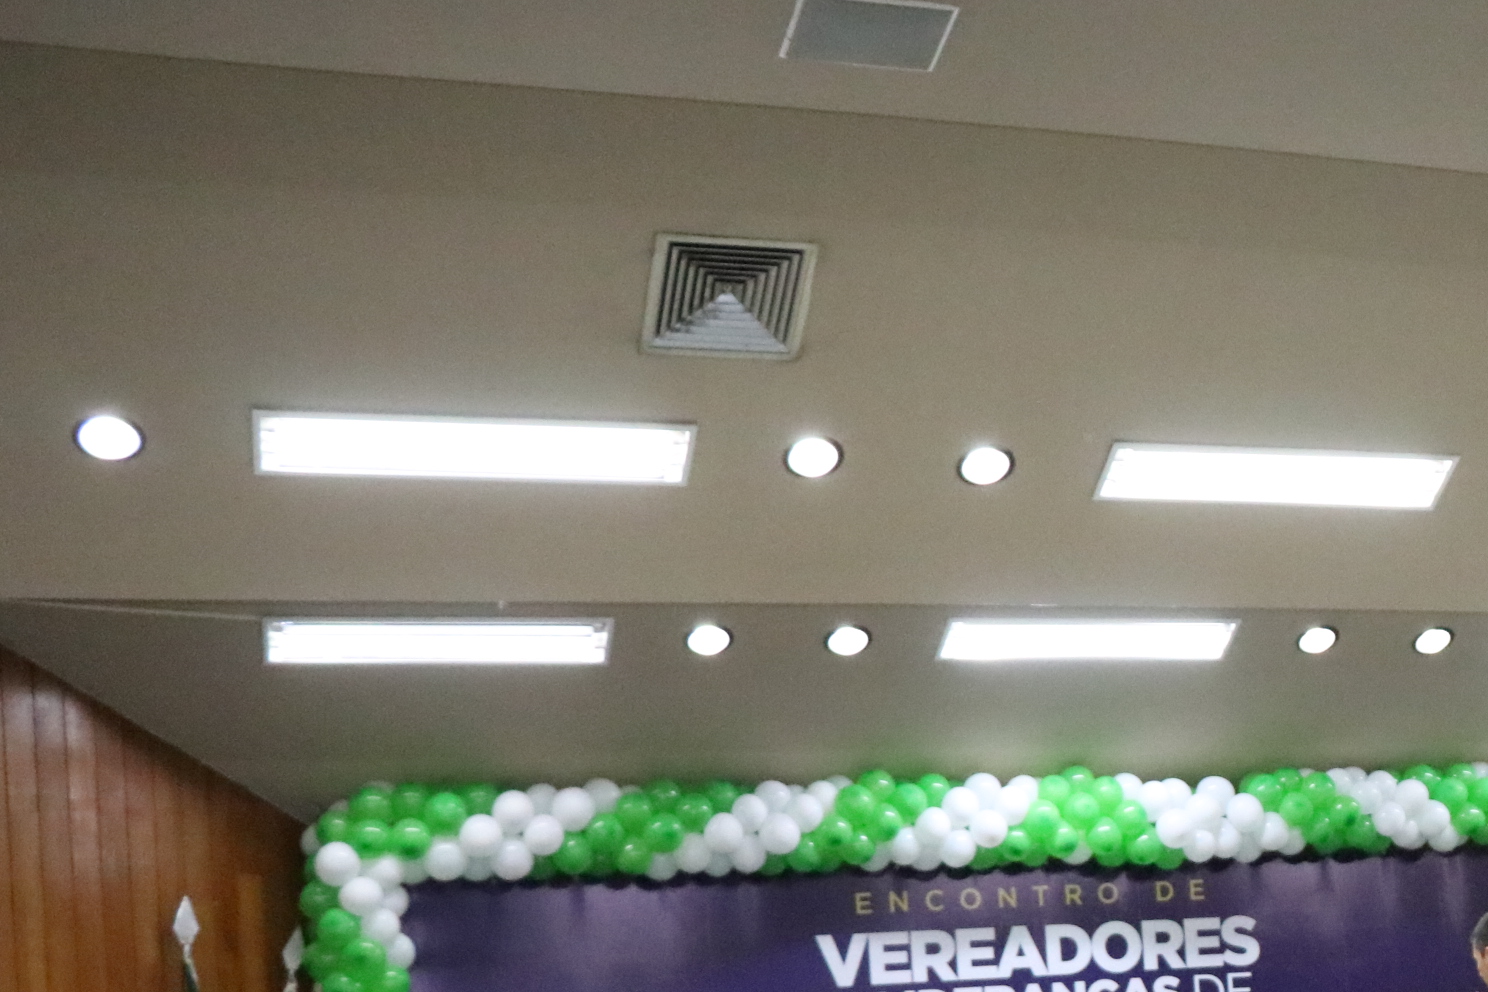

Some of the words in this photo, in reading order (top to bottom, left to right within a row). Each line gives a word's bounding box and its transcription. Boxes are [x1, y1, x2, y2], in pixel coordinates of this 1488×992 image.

[854, 881, 1120, 916] ENCONTRO
[1155, 878, 1206, 902] DE
[814, 914, 1261, 988] VEREADORES
